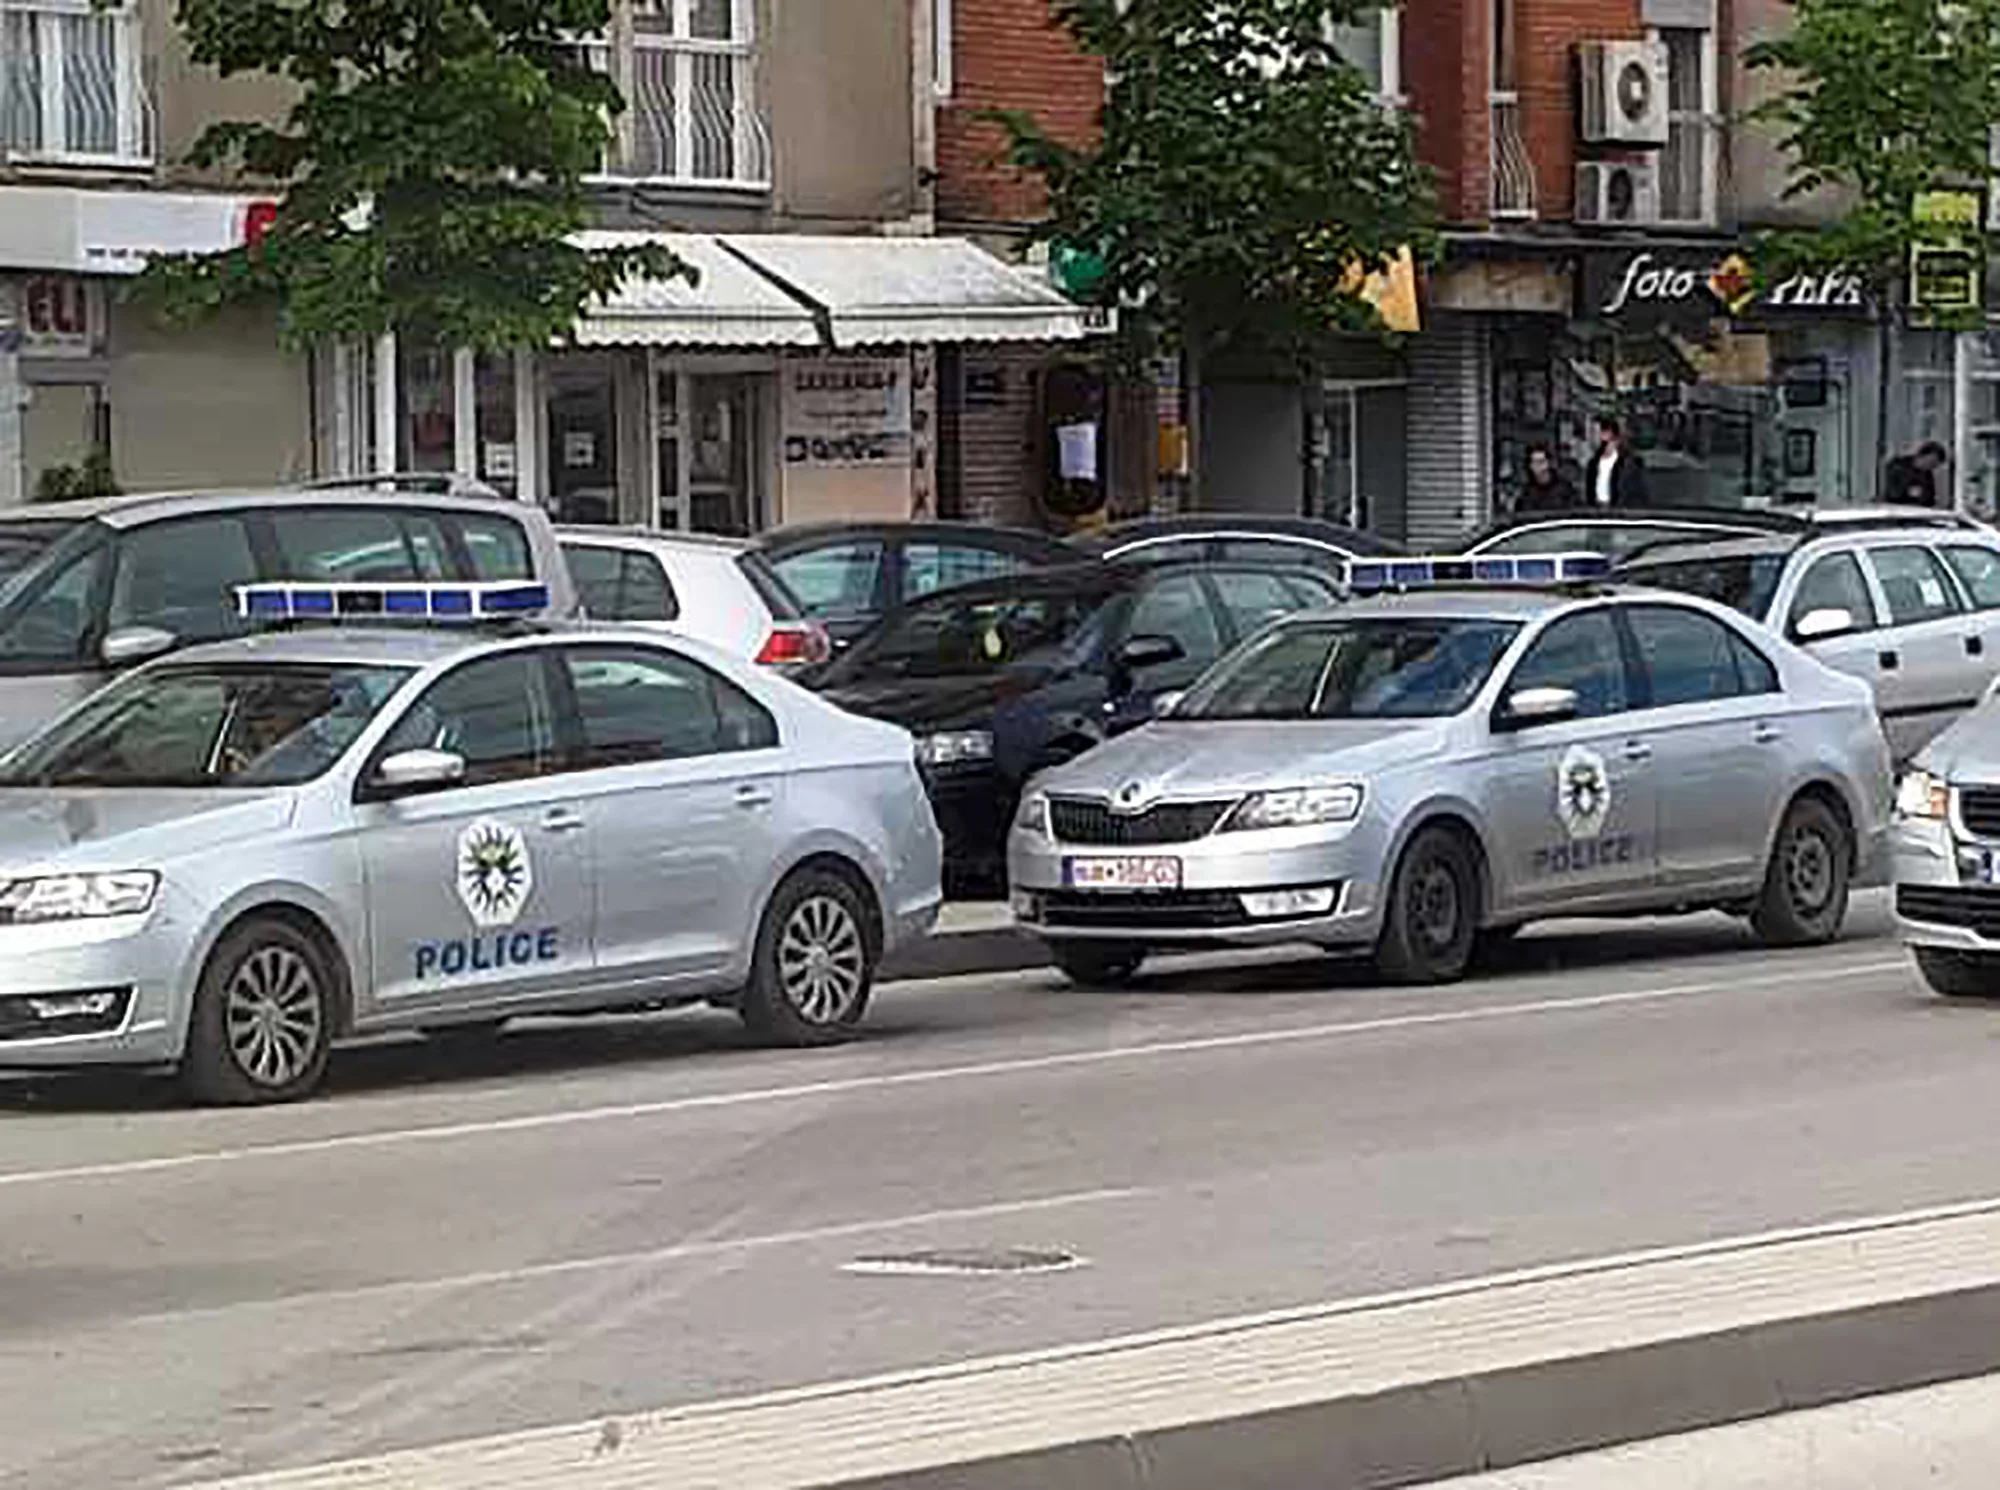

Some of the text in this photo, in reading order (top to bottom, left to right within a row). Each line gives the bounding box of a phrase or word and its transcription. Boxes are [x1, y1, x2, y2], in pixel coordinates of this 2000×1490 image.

[1601, 253, 1694, 313] foto
[1532, 834, 1636, 878] POLICE
[415, 927, 559, 979] POLICE
